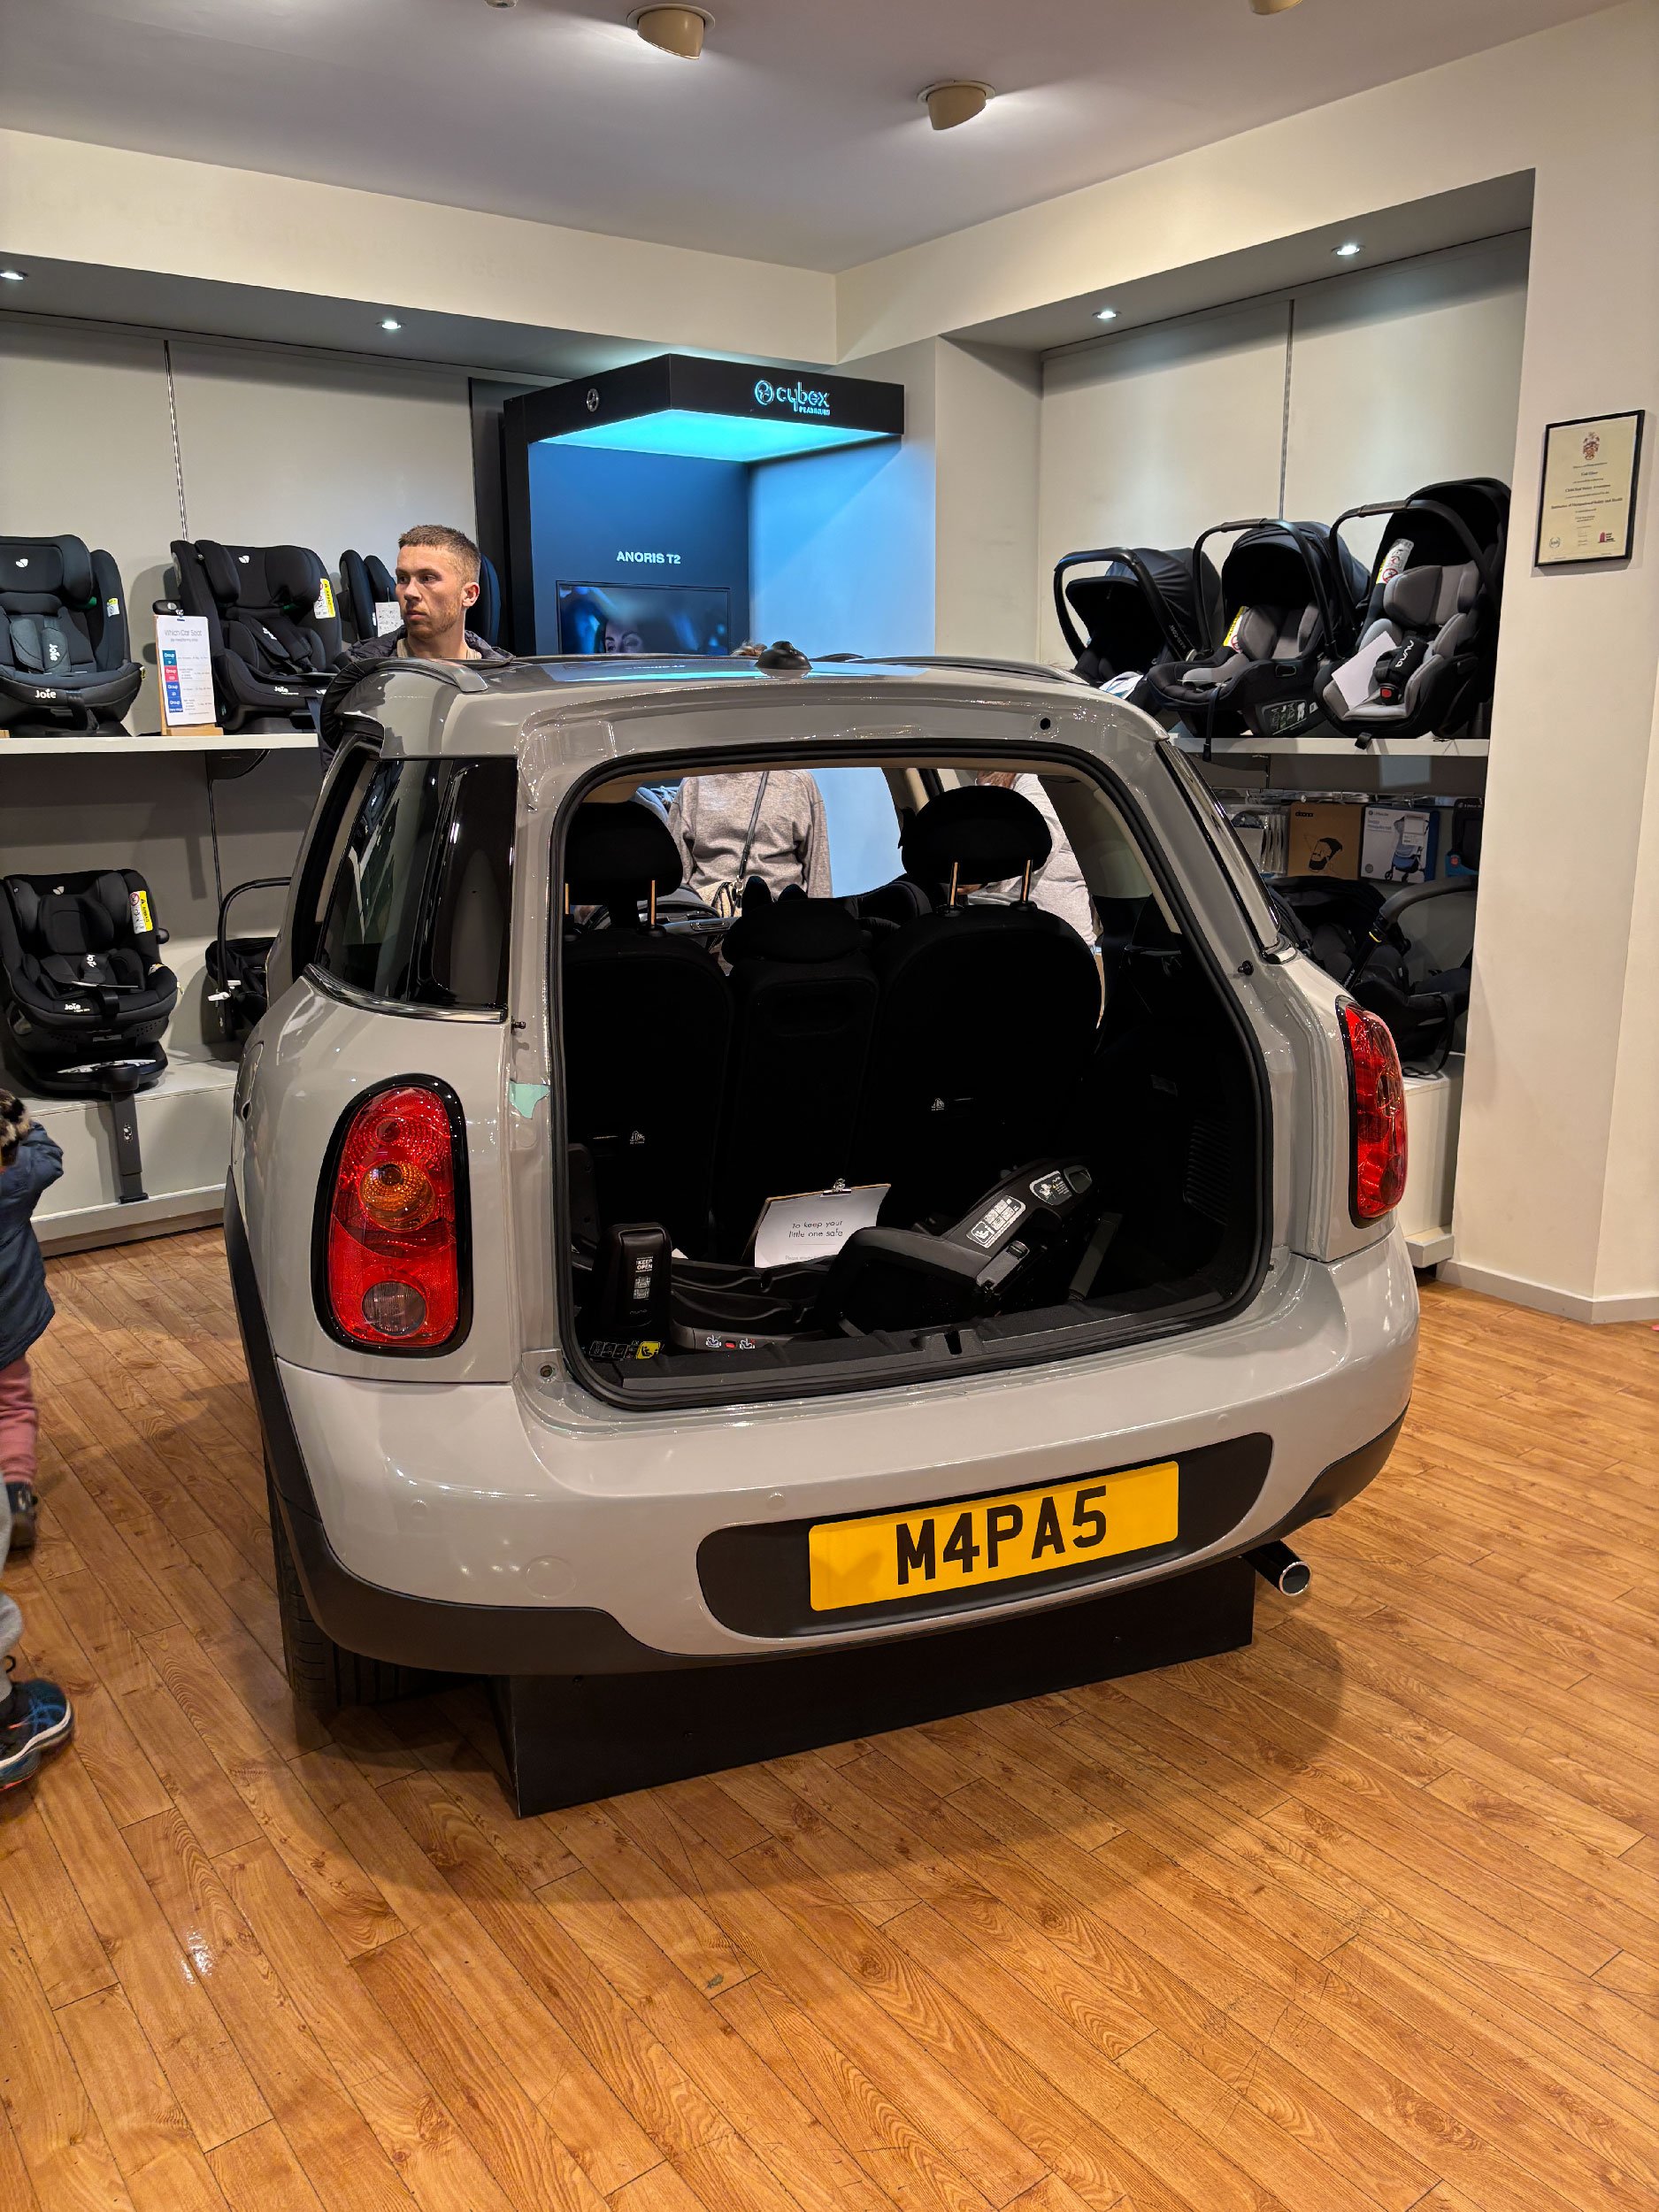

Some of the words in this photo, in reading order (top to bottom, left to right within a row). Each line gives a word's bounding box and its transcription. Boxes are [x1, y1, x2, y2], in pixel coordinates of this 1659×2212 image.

[776, 381, 830, 412] cybex
[616, 550, 664, 564] ANORIS
[666, 553, 681, 565] T2
[50, 643, 60, 661] Joie
[35, 688, 57, 698] Joie
[895, 1485, 1108, 1586] M4PA5
